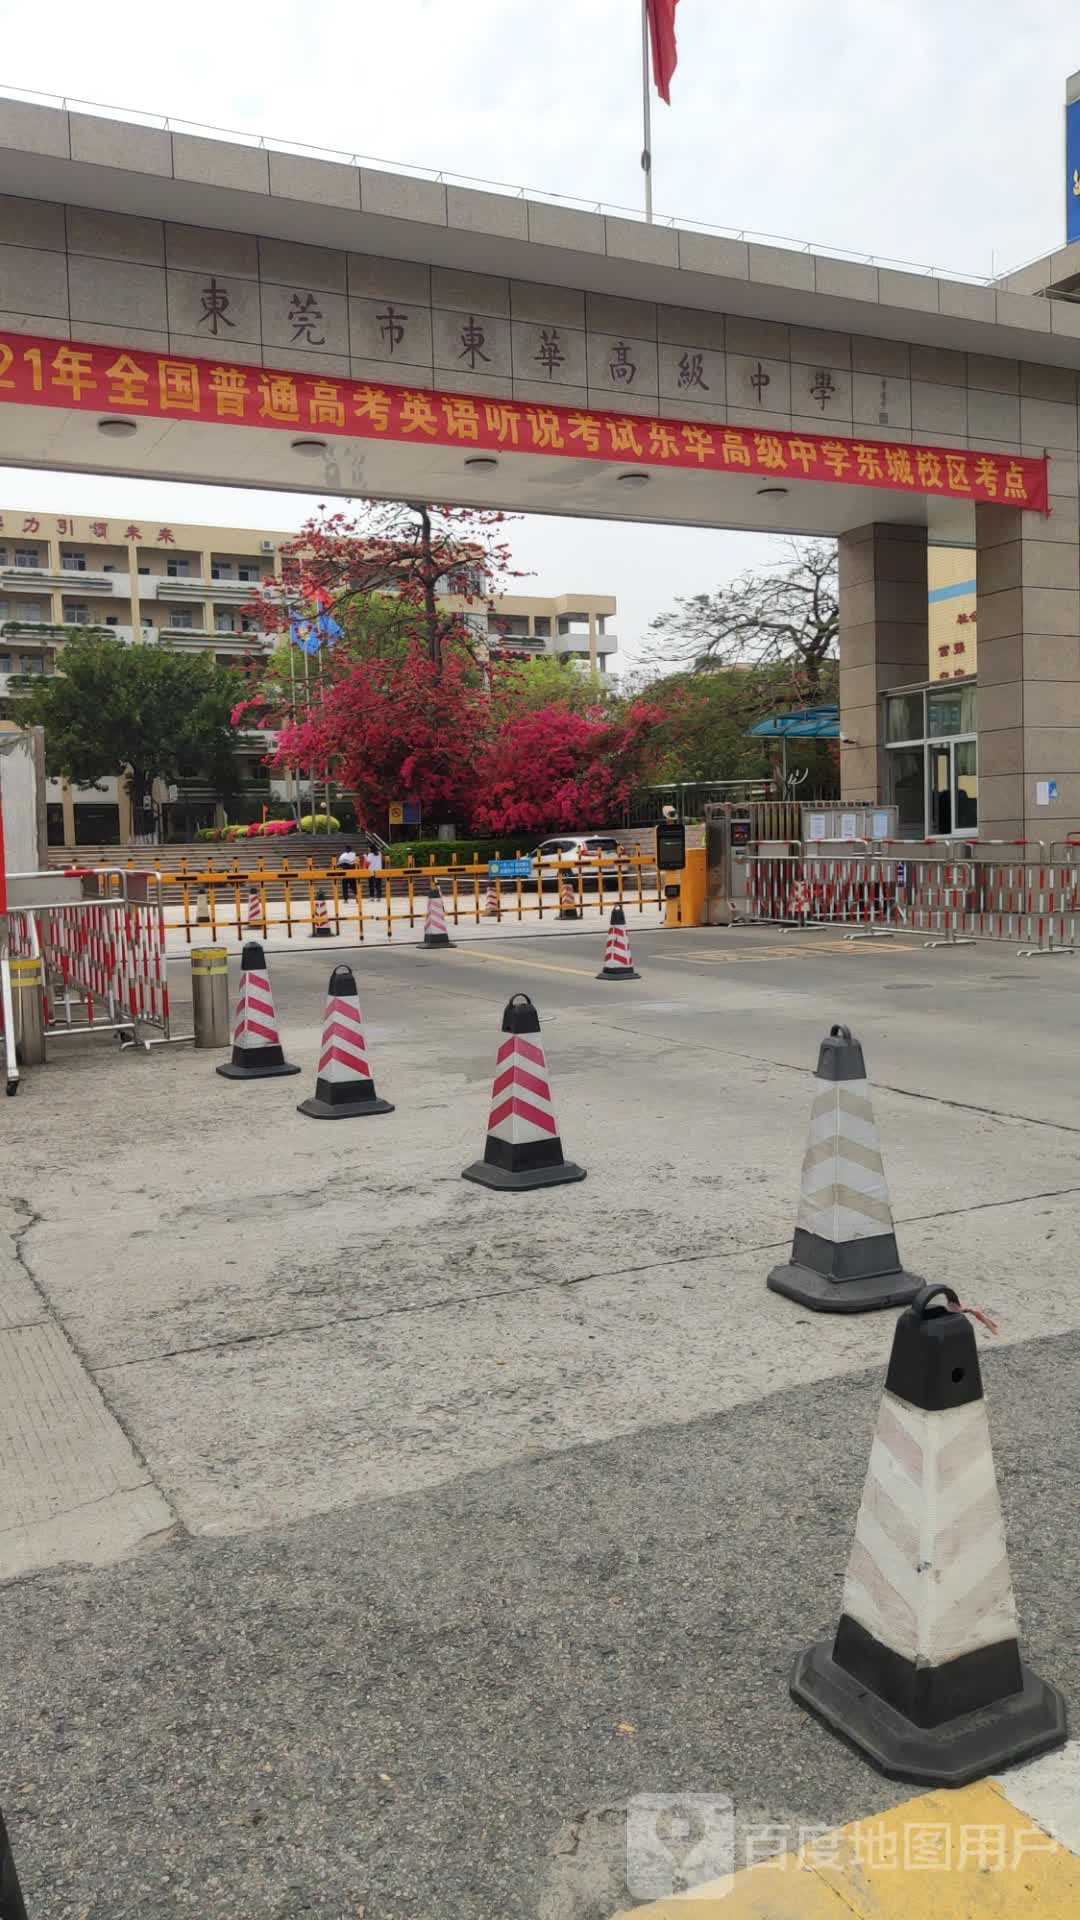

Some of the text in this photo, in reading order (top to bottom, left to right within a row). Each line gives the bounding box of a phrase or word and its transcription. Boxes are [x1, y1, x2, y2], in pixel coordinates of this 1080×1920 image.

[199, 277, 836, 411] 東莞市東華高級中學
[0, 516, 176, 544] 力引领未来
